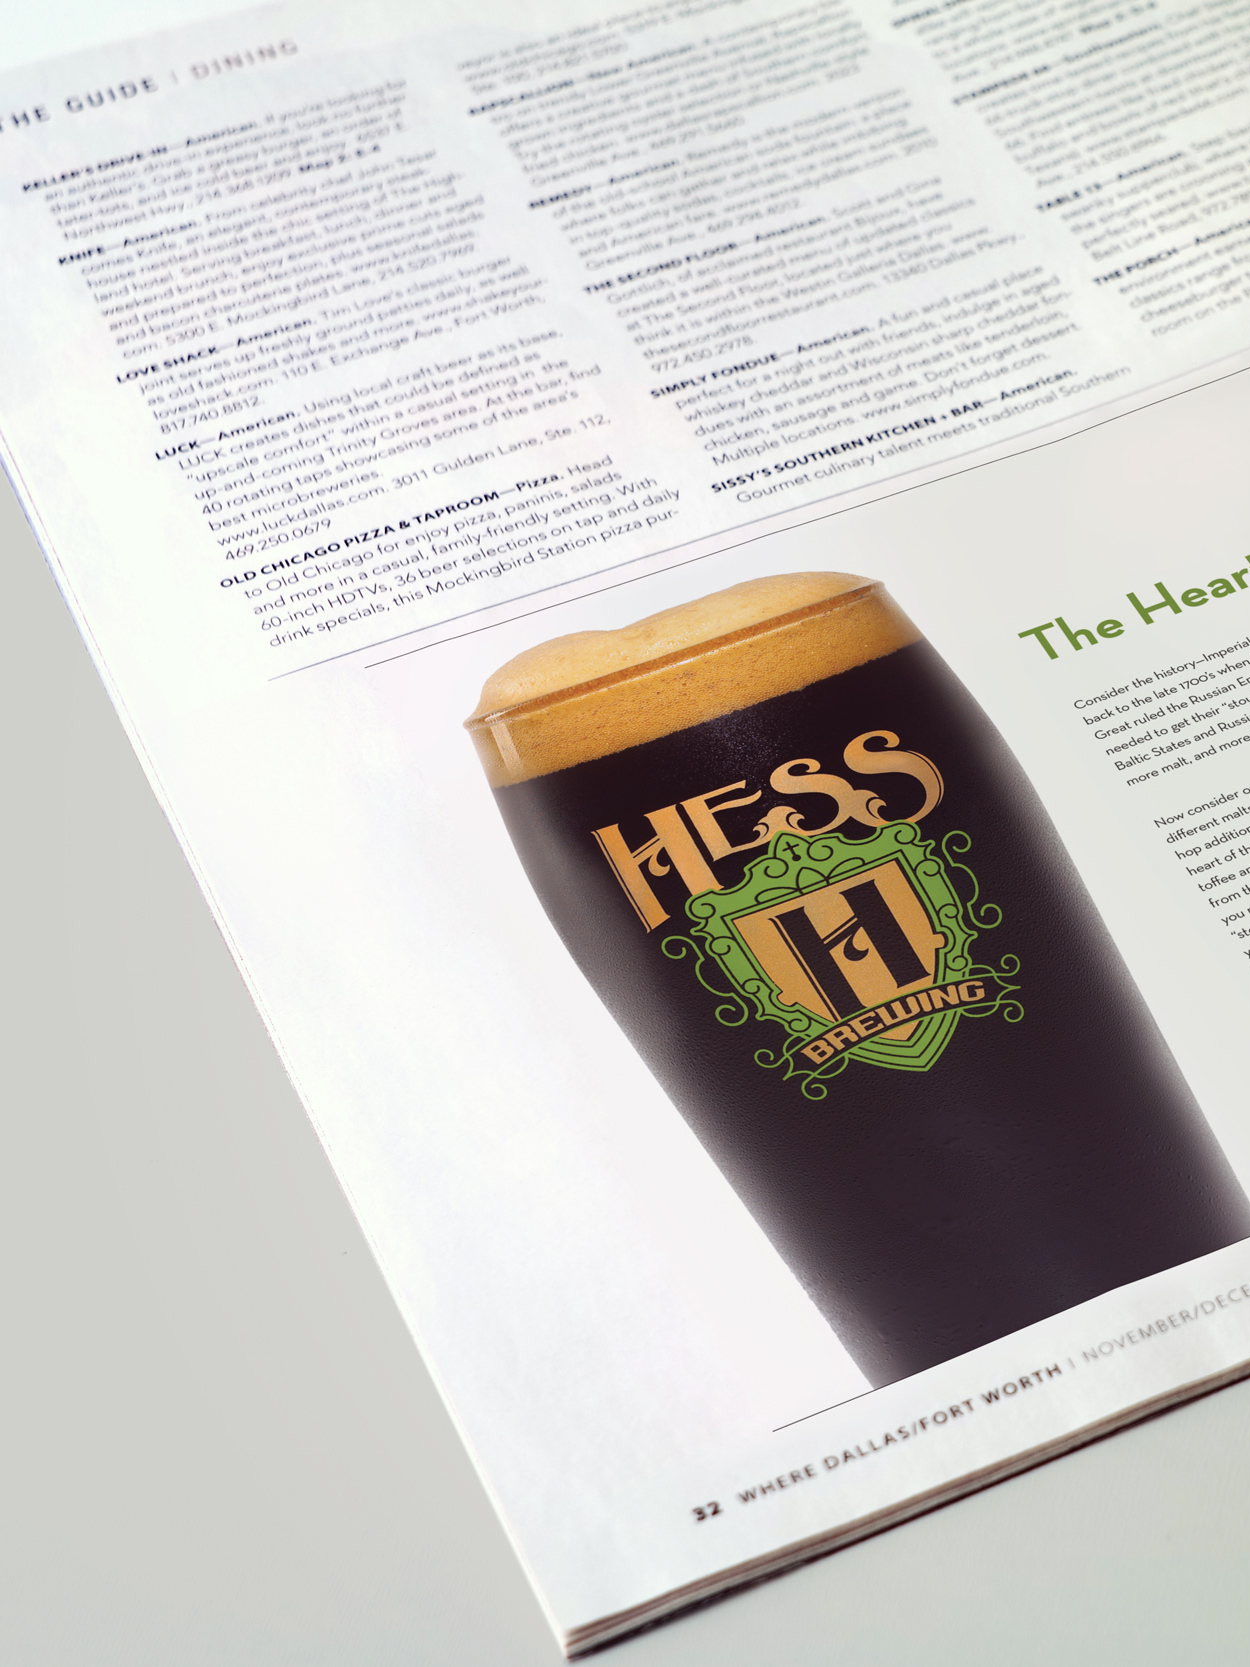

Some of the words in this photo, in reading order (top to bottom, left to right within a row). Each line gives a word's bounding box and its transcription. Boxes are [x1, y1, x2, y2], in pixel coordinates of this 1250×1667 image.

[63, 75, 158, 114] GUIDE
[189, 40, 298, 80] DINING
[1093, 267, 1124, 287] THE
[649, 373, 707, 399] SIMPLY
[711, 439, 780, 466] Multiple
[780, 416, 859, 444] locations.
[736, 473, 812, 503] Gourmet
[813, 453, 875, 479] culinary
[877, 437, 925, 458] talent
[926, 422, 977, 443] meets
[977, 390, 1058, 426] traditional
[1058, 366, 1131, 397] Southern
[773, 437, 865, 474] SOUTHERN
[863, 414, 938, 444] KITCHEN
[207, 512, 248, 531] best
[251, 470, 383, 518] microbreweries.
[216, 486, 389, 546] www.luckdallas.com.
[391, 468, 428, 489] 3011
[432, 450, 495, 474] Gulden
[496, 437, 543, 456] Lane,
[544, 427, 576, 441] Ste.
[579, 413, 611, 429] 112,
[219, 570, 257, 588] OLD
[260, 541, 341, 575] CHICAGO
[343, 524, 396, 548] PIZZA
[398, 519, 412, 530] &
[411, 473, 564, 525] TAPROOM—Pizza.
[566, 454, 613, 476] Head
[225, 517, 331, 560] 469.250.0679
[243, 587, 262, 599] to
[265, 571, 299, 591] Old
[302, 550, 374, 579] Chicago
[376, 540, 399, 555] for
[404, 525, 449, 546] enjoy
[453, 510, 501, 533] pizza,
[503, 489, 568, 517] paninis,
[570, 471, 622, 494] salads
[261, 602, 325, 631] 60-inch
[326, 582, 392, 608] HDTVs,
[394, 571, 416, 587] 36
[417, 559, 458, 579] beer
[462, 531, 547, 565] selections
[550, 524, 573, 537] on
[574, 514, 603, 528] tap
[607, 498, 639, 519] and
[642, 488, 679, 507] daily
[269, 624, 314, 647] drink
[316, 602, 390, 632] specials,
[392, 590, 424, 606] this
[425, 550, 535, 595] Mockingbird
[536, 535, 597, 560] Station
[599, 520, 643, 543] pizza
[645, 509, 679, 528] pur-
[1018, 616, 1125, 660] The
[1073, 684, 1129, 709] Consider
[1131, 677, 1153, 688] the
[591, 729, 945, 934] HESS
[1153, 812, 1184, 828] Now
[1187, 791, 1238, 815] consider
[1197, 873, 1236, 891] toffee
[801, 978, 986, 1066] BREWING
[690, 1500, 724, 1524] 32
[735, 1463, 818, 1505] WHERE
[821, 1397, 974, 1472] DALLAS/FORT
[979, 1362, 1062, 1406] WORTH
